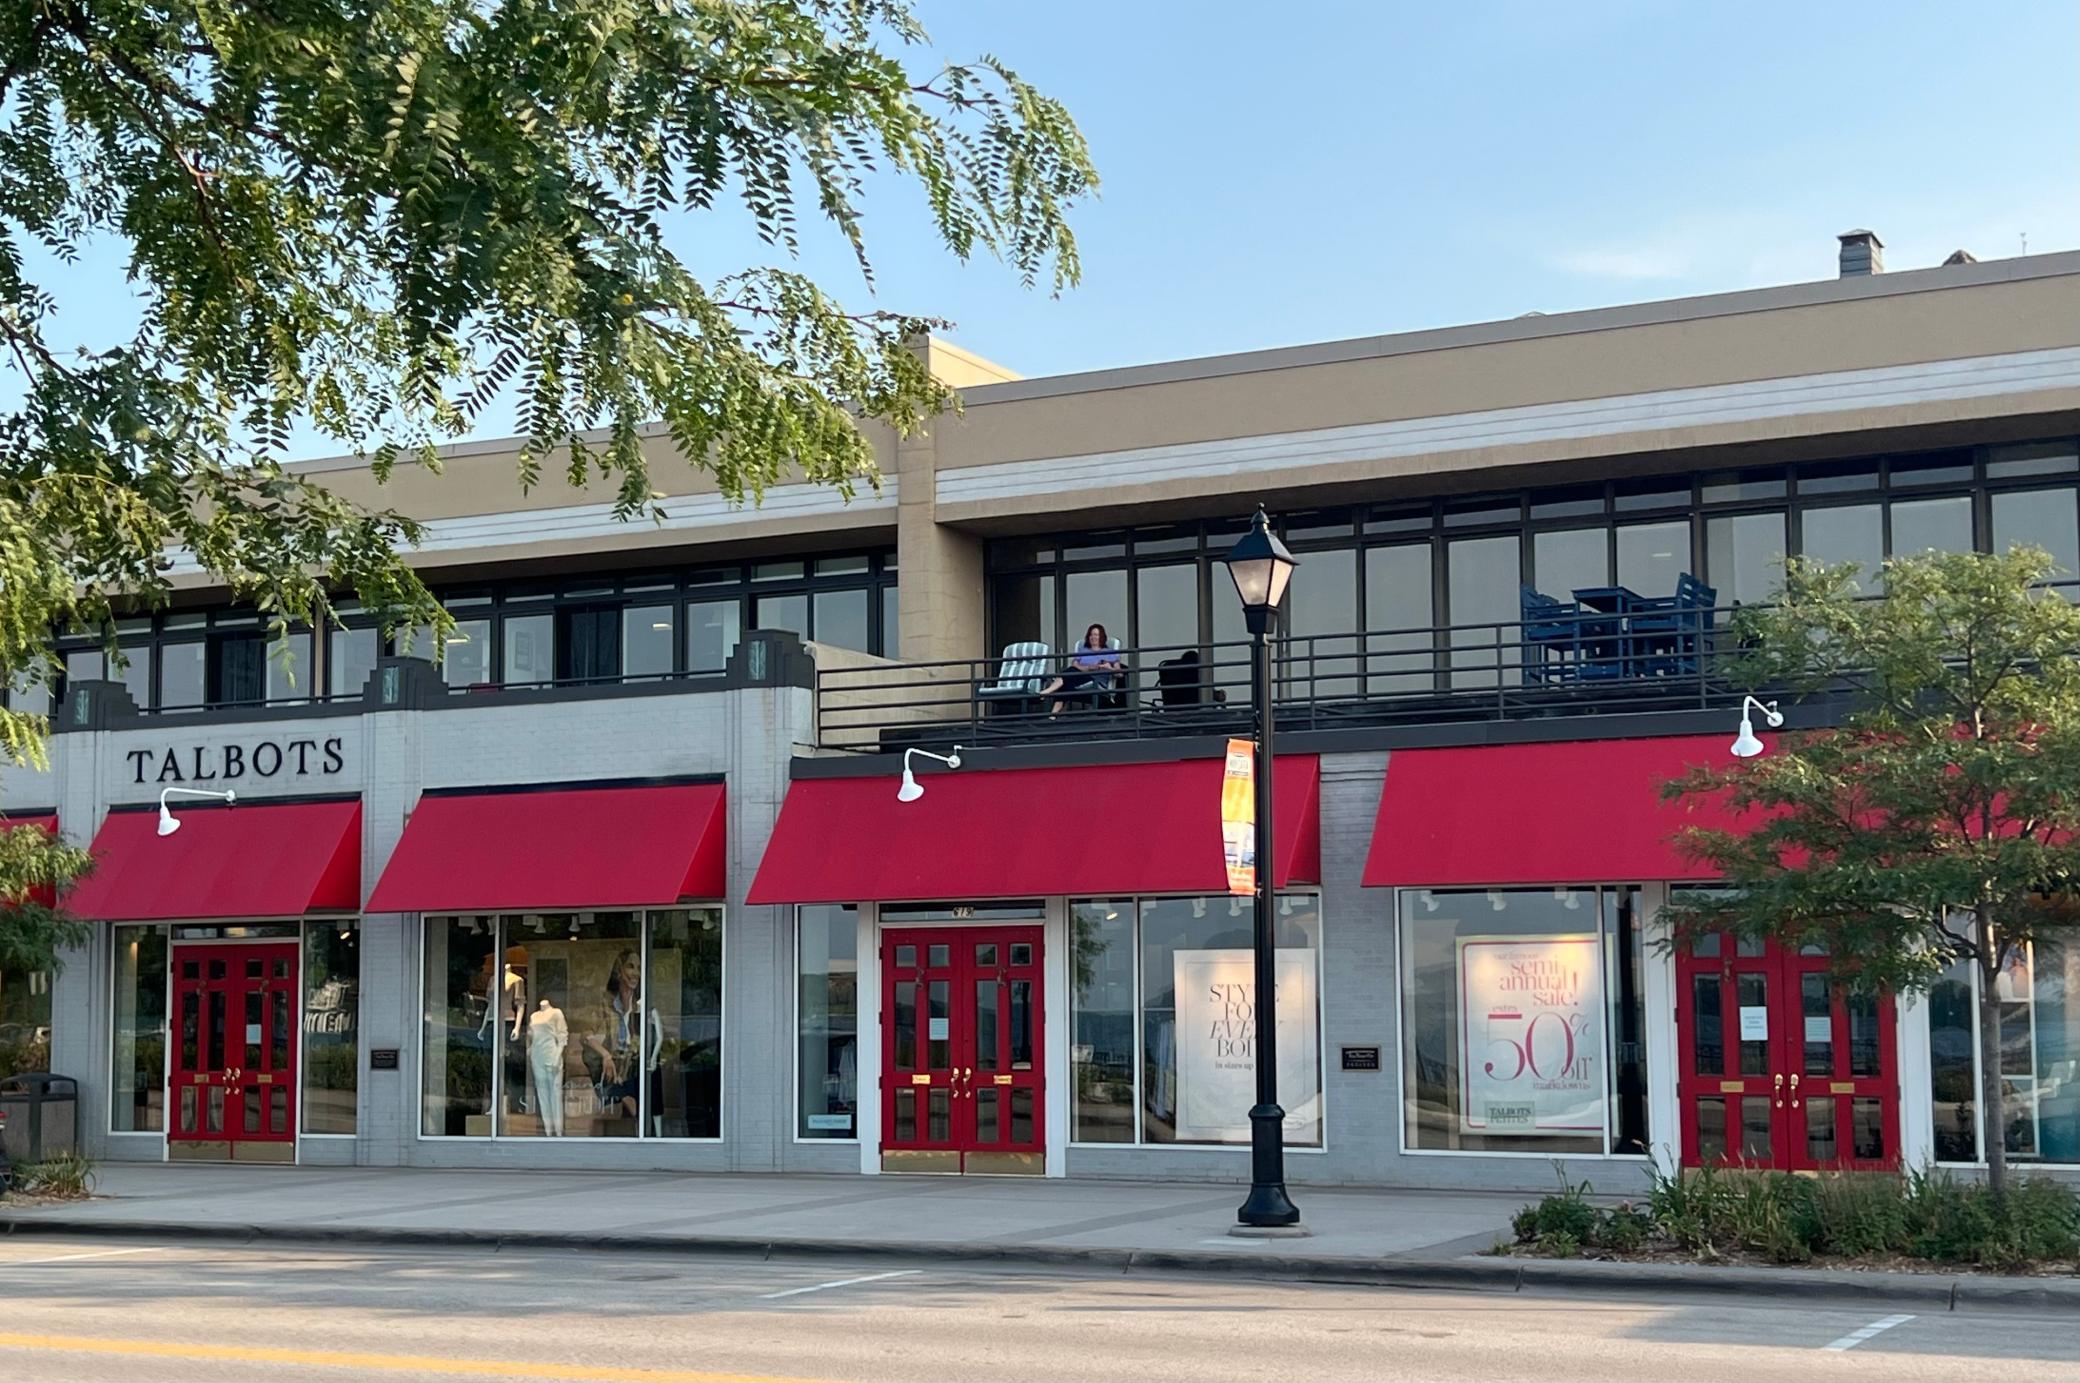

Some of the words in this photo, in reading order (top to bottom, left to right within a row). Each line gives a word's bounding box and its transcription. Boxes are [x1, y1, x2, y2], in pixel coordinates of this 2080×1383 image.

[126, 737, 344, 783] TALBOTS
[1500, 965, 1568, 991] annual
[1209, 984, 1280, 1003] STY
[1225, 1002, 1253, 1021] FO
[1489, 1107, 1531, 1115] TALBOTS
